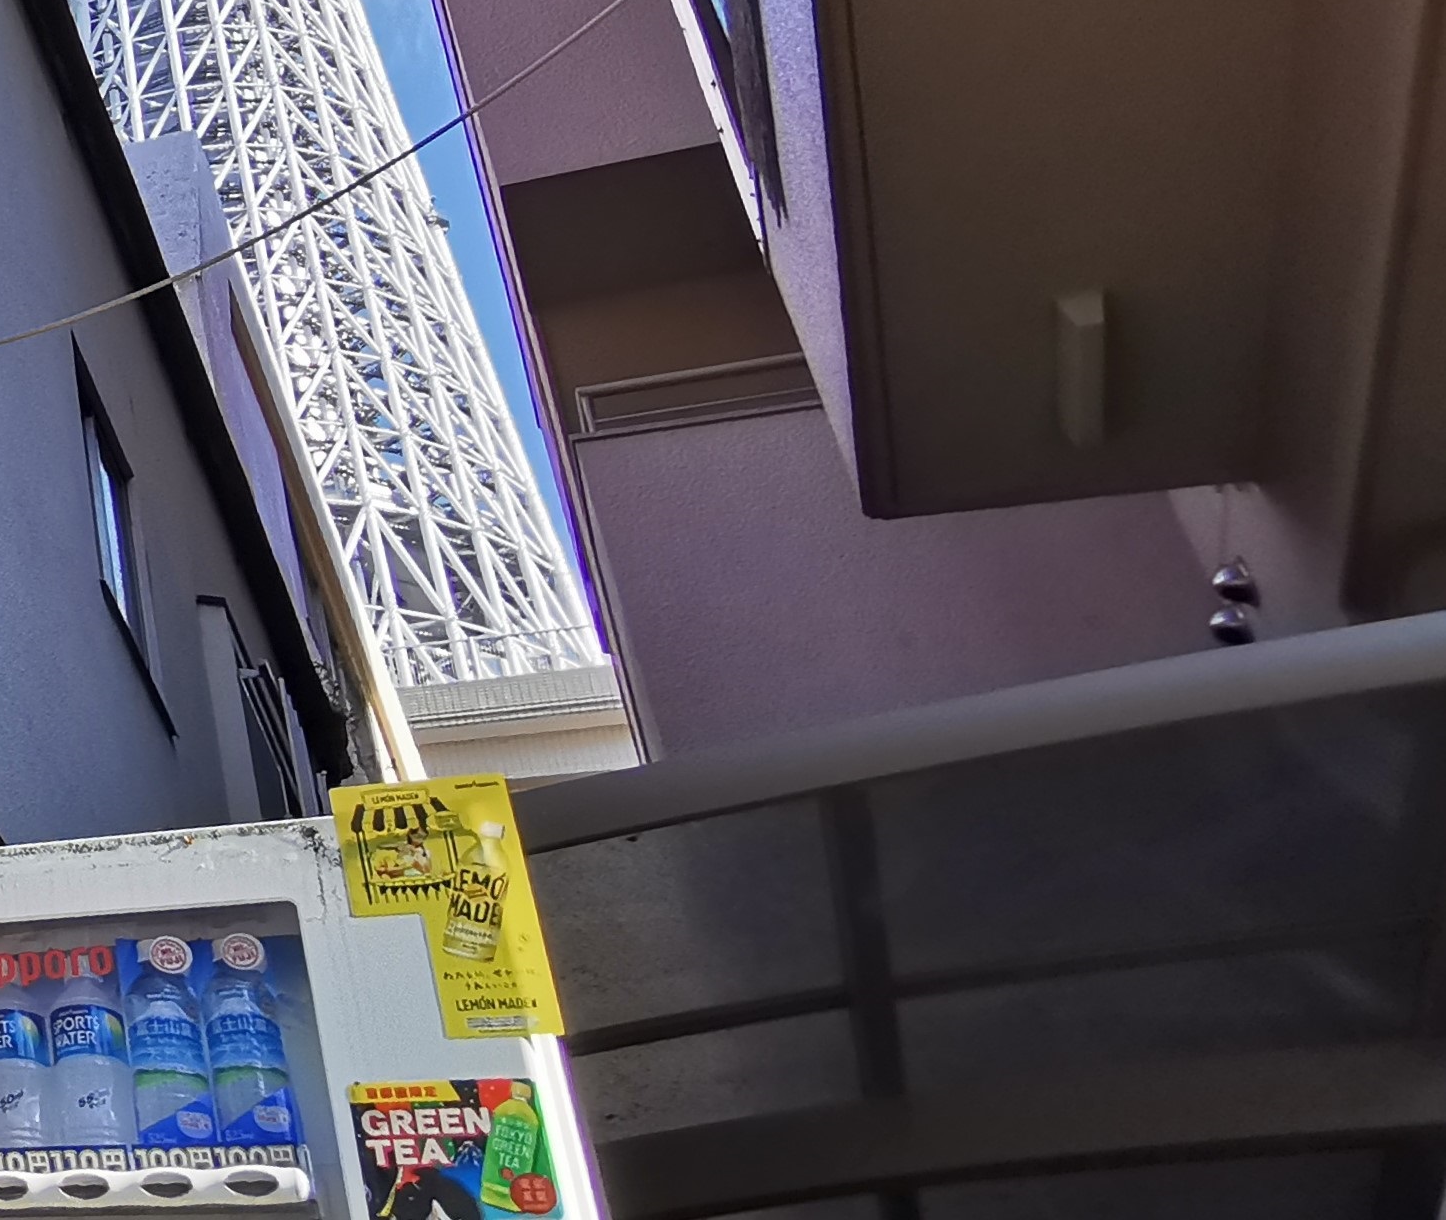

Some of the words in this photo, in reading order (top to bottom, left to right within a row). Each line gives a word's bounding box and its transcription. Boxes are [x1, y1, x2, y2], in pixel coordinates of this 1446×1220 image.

[361, 1106, 492, 1137] GREEN
[50, 1148, 127, 1172] 110円
[134, 1147, 212, 1170] 100円
[213, 1145, 294, 1168] 100円
[365, 1137, 454, 1166] TEA
[499, 1152, 521, 1169] TEA
